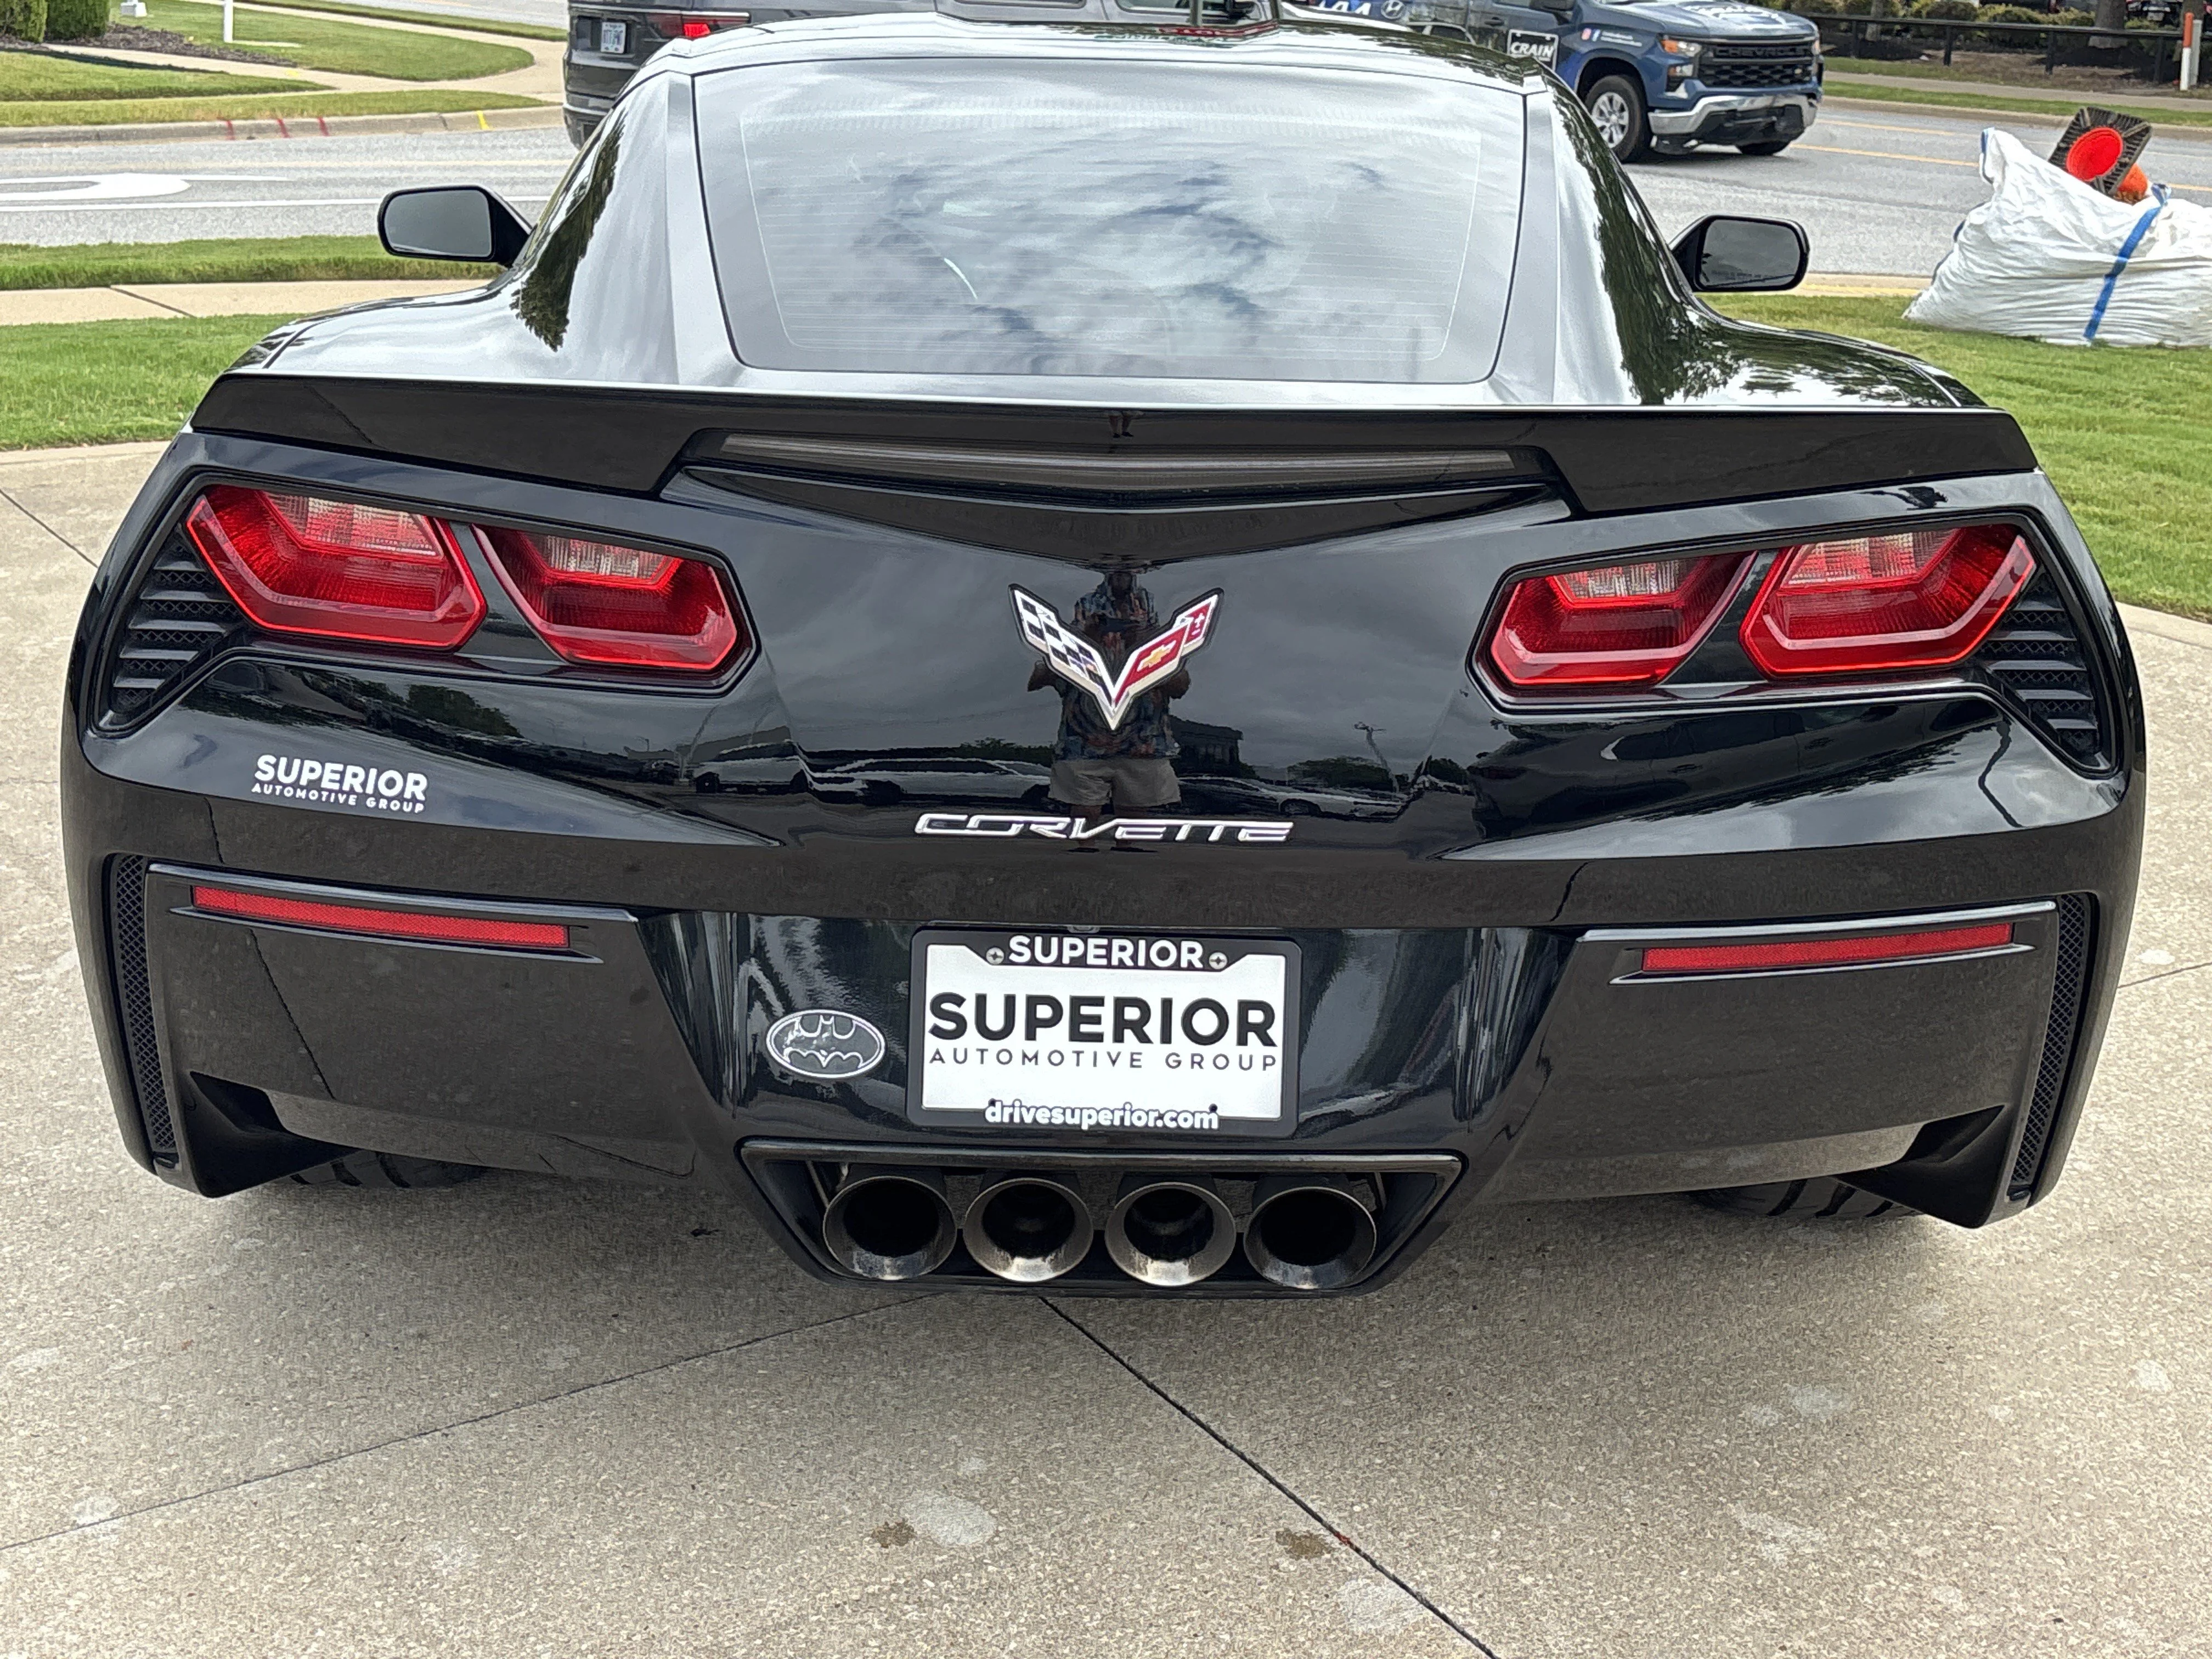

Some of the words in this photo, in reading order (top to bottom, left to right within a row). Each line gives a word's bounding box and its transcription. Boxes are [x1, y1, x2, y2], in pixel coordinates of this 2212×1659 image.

[1510, 42, 1554, 57] CRAIN
[255, 754, 427, 800] SUPERIOR
[251, 783, 357, 805] AUTOMOTIVE
[366, 797, 424, 813] GROUP
[915, 813, 1293, 842] CORVETTE
[1008, 935, 1203, 968] SUPERIOR
[929, 992, 1277, 1047] SUPERIOR
[929, 1048, 1142, 1068] AUTOMOTIVE
[1165, 1053, 1276, 1071] GROUP
[985, 1099, 1218, 1130] drivesuperior.com
